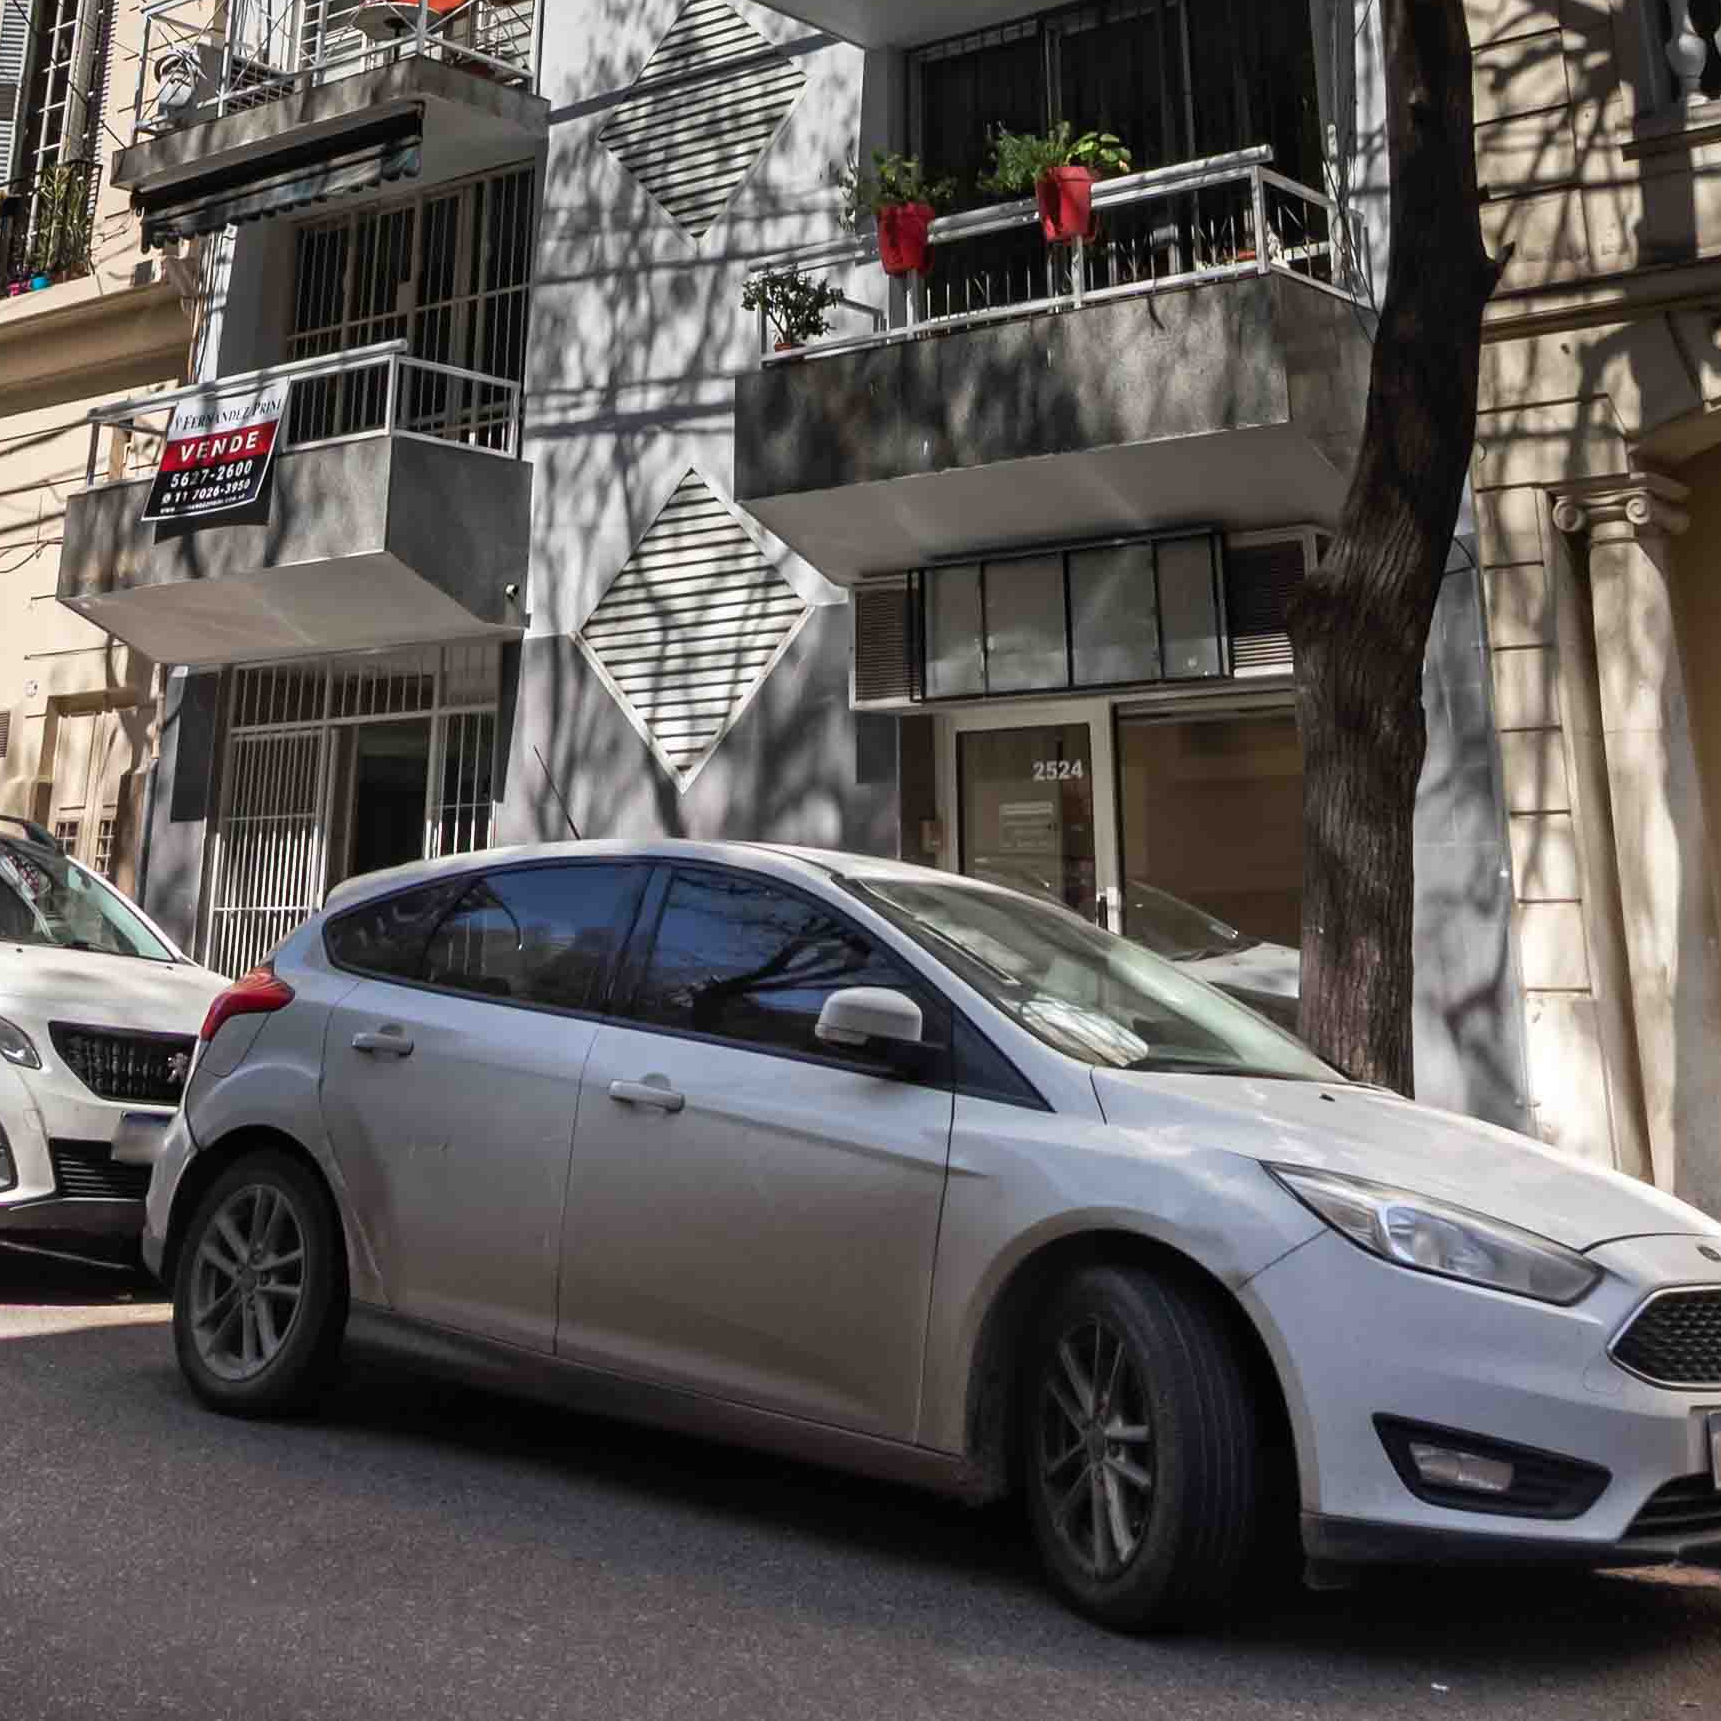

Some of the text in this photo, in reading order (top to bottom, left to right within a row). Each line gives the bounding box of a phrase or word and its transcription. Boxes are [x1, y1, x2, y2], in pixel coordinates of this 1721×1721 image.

[180, 430, 259, 462] VENDE
[170, 460, 254, 488] 5627-2600
[1032, 759, 1083, 781] 2524
